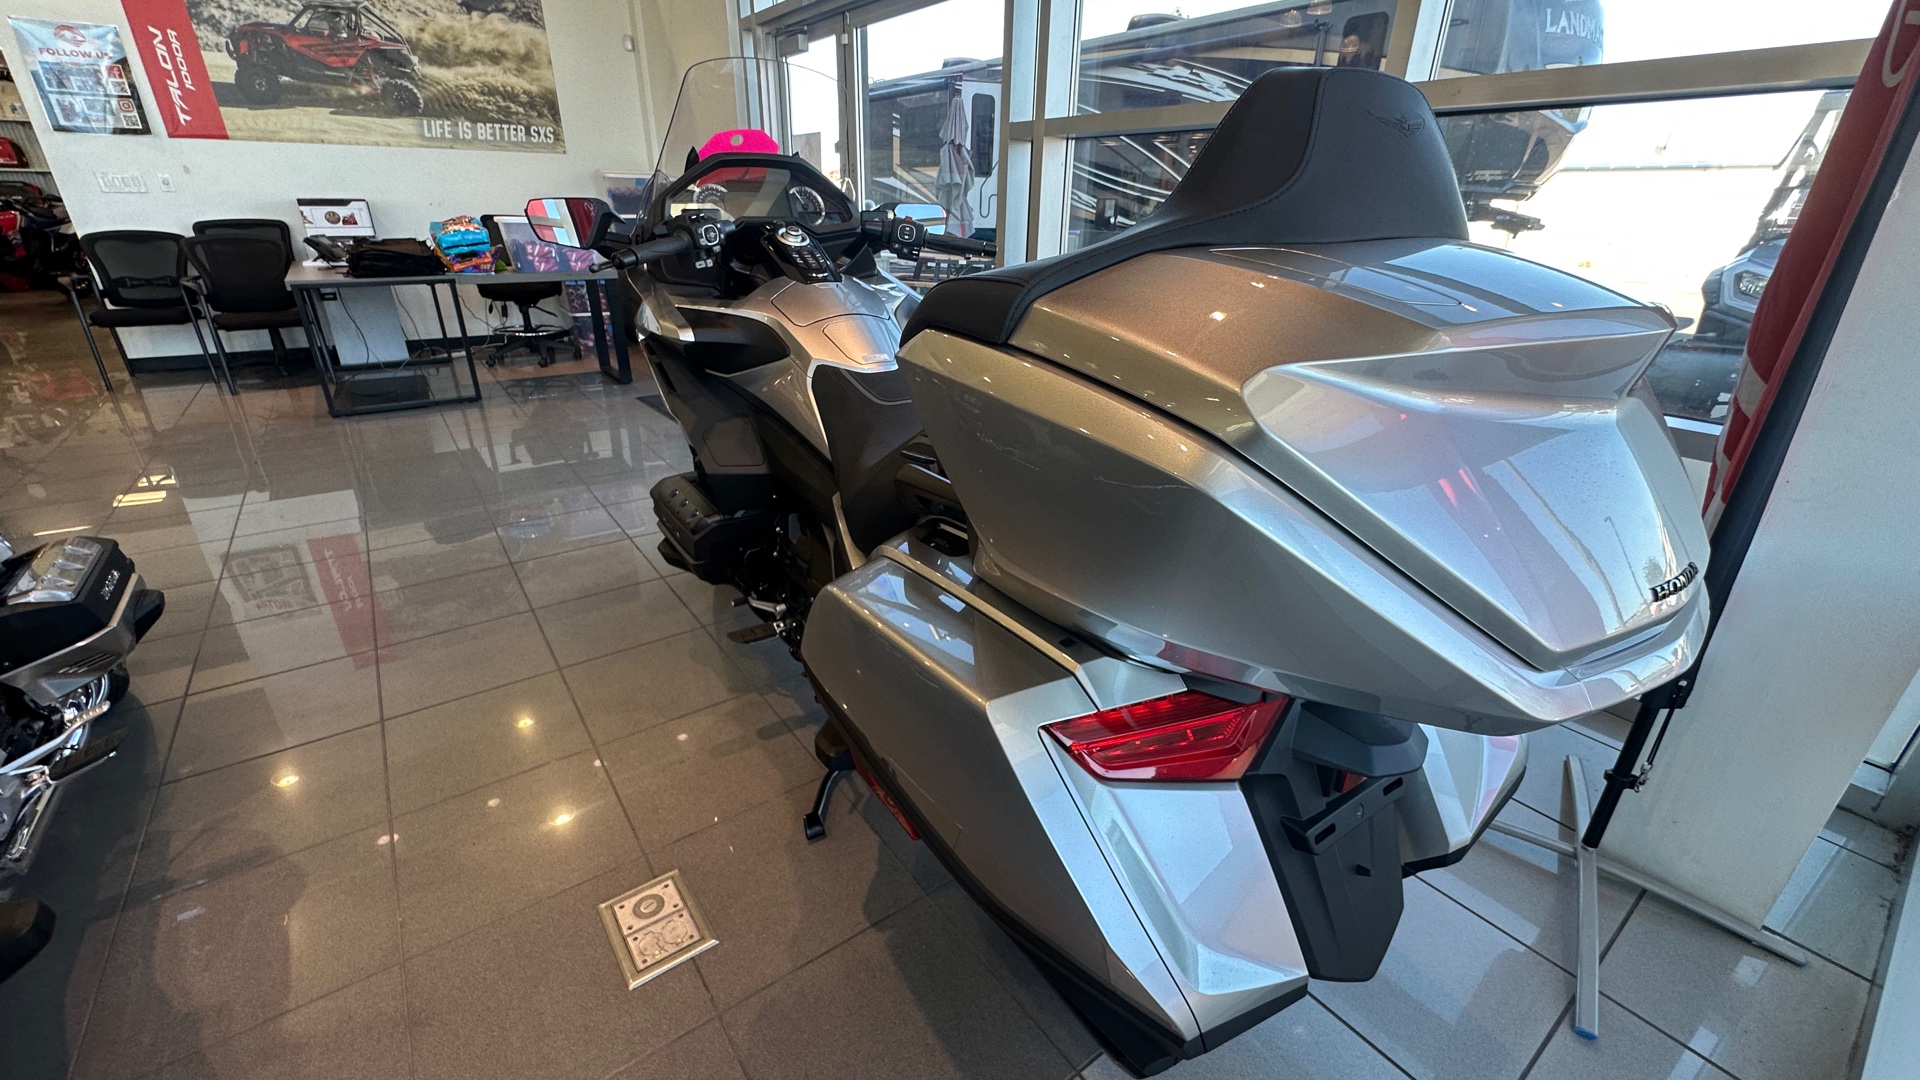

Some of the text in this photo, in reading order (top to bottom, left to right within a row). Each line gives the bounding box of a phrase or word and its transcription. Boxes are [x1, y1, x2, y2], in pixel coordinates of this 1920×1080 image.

[38, 47, 92, 59] FOLLOW
[166, 28, 196, 92] 1000R
[147, 24, 192, 126] TALON
[423, 119, 555, 144] LIFE IS BETTER SXS
[1650, 561, 1699, 602] HONDA
